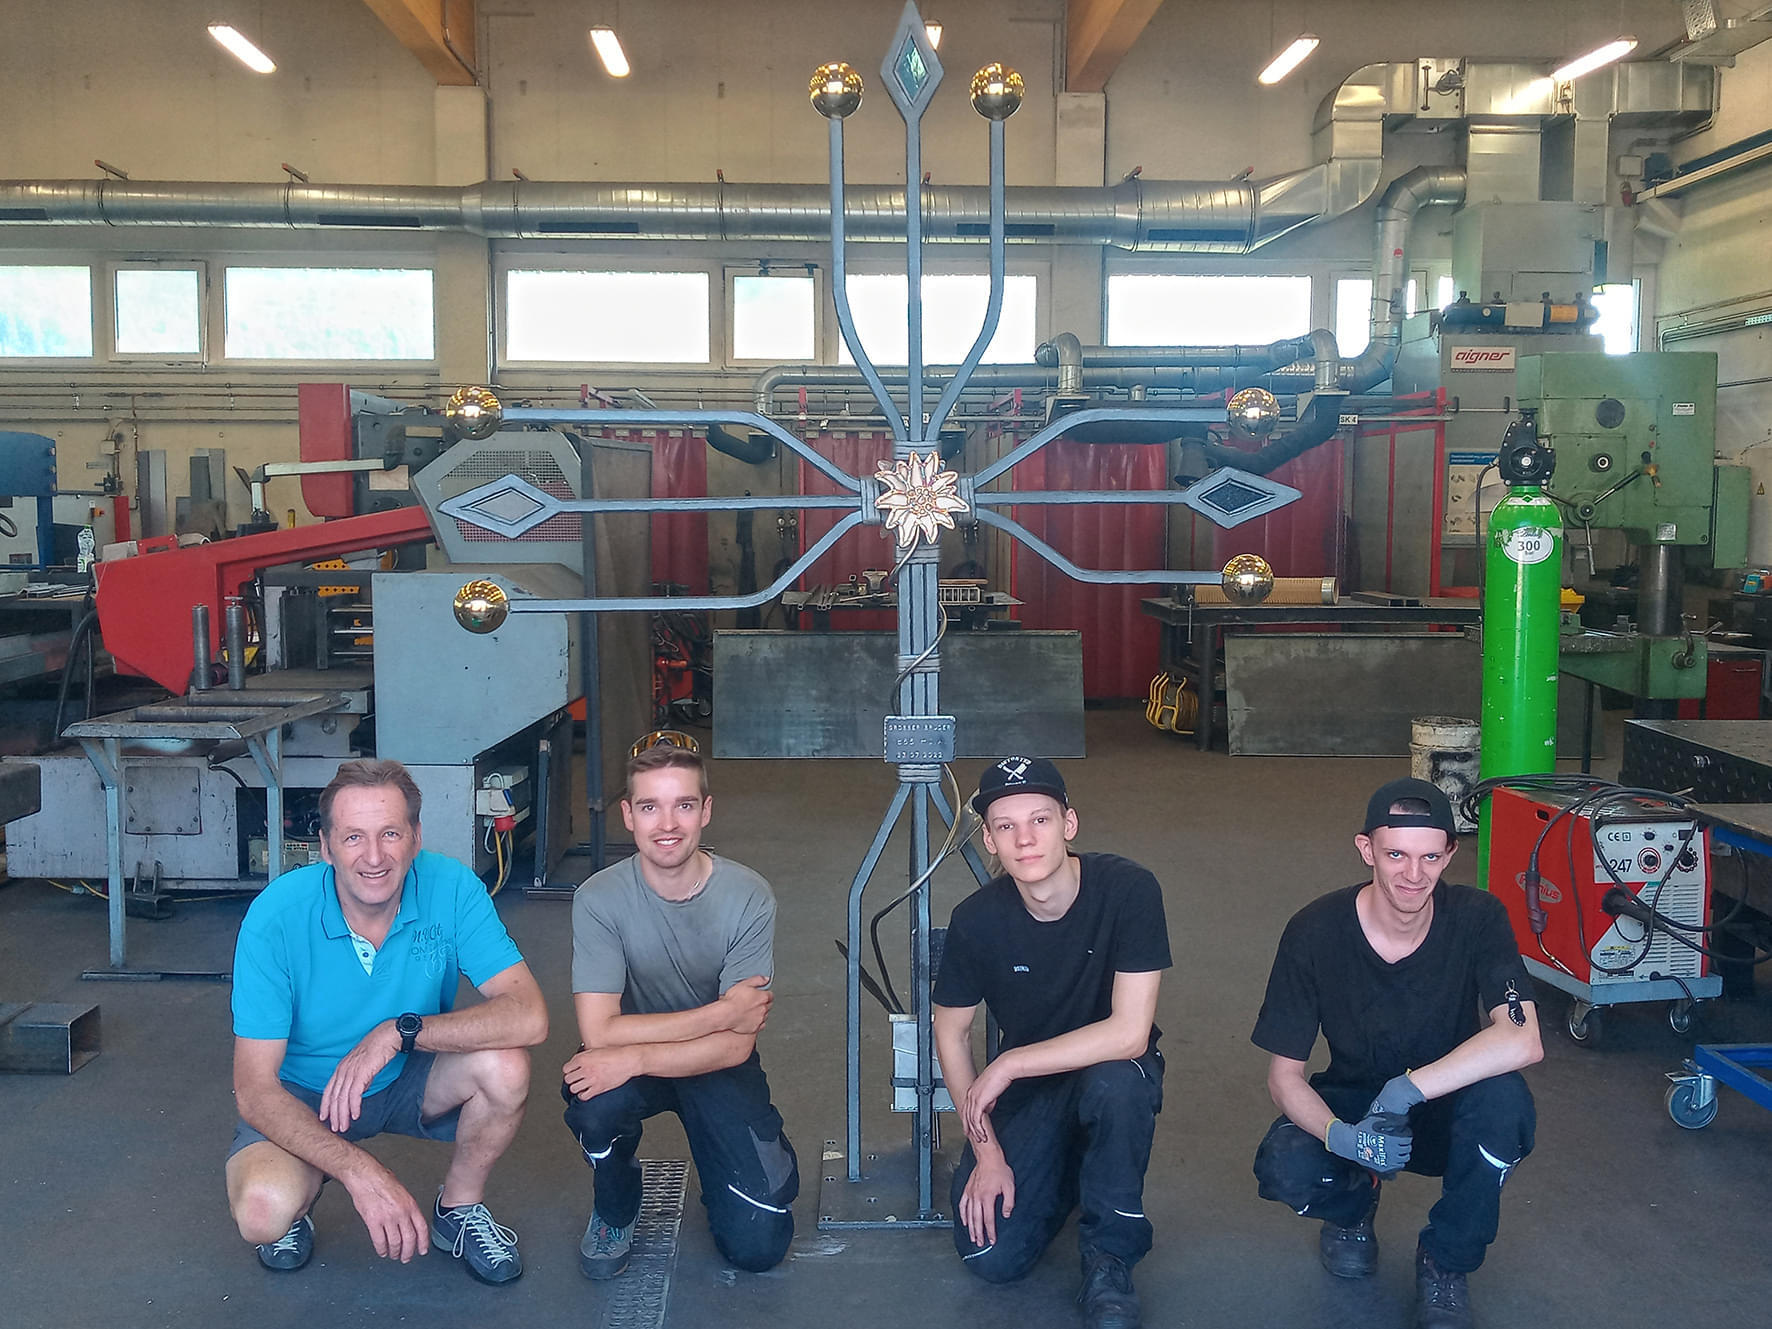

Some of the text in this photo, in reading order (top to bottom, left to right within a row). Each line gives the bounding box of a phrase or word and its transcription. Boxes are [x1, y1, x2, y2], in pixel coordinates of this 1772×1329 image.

[1455, 349, 1510, 363] aigner
[1517, 540, 1541, 552] 300
[1609, 858, 1633, 873] 247
